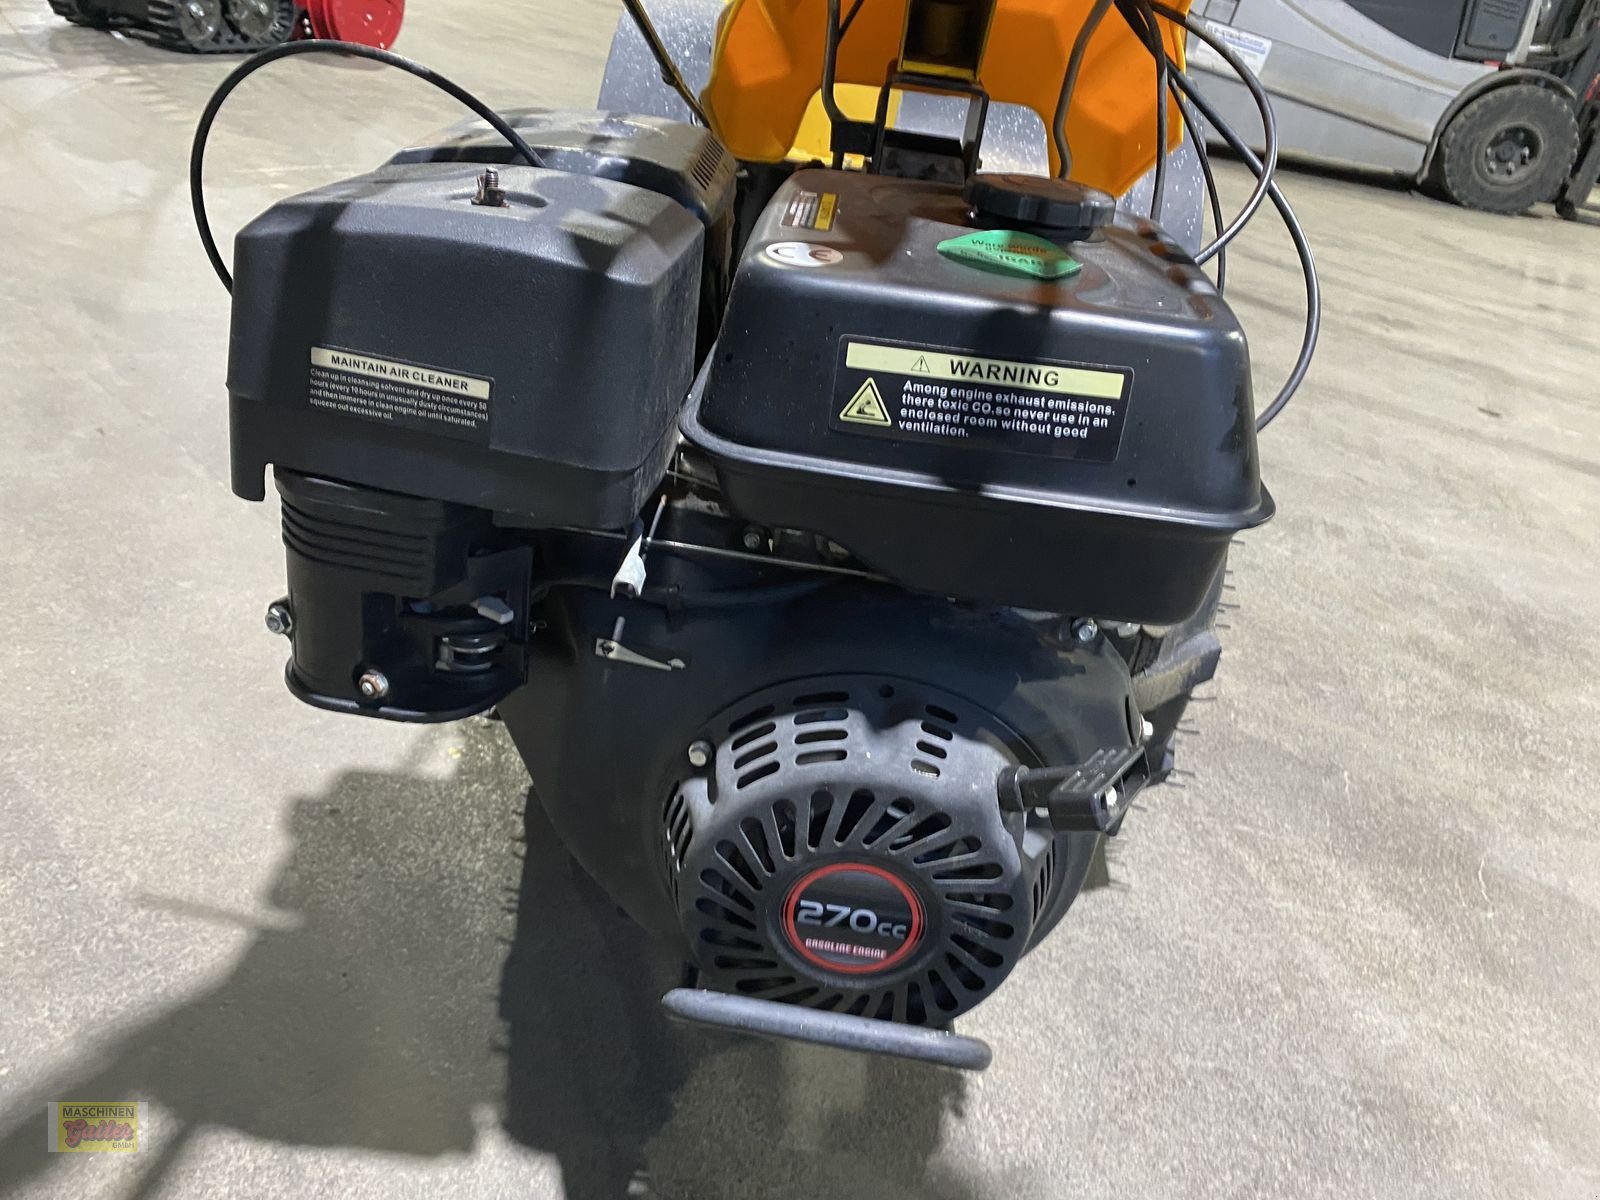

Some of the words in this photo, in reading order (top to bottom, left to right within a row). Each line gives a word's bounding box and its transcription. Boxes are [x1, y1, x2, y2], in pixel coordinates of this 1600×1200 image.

[331, 354, 387, 375] MAINTAIN
[389, 367, 410, 380] AIR
[412, 371, 469, 391] CLEANER
[950, 359, 1060, 386] WARNING
[310, 368, 330, 378] Clean
[340, 373, 347, 381] in
[347, 376, 380, 390] cleansing
[381, 382, 406, 394] solvent
[406, 388, 419, 396] and
[420, 390, 431, 400] dry
[431, 393, 441, 401] up
[441, 395, 458, 404] once
[459, 400, 478, 410] every
[310, 378, 329, 387] hours
[329, 382, 350, 393] (every
[359, 387, 378, 398] hours
[379, 391, 386, 400] in
[418, 399, 438, 410] dusty
[310, 388, 322, 397] and
[323, 390, 338, 400] then
[339, 393, 368, 406] immerse
[368, 398, 375, 407] in
[375, 401, 394, 411] clean
[394, 405, 417, 416] engine
[417, 408, 427, 417] oil
[427, 411, 443, 420] until
[903, 379, 948, 399] Among
[950, 387, 993, 401] engine
[995, 392, 1046, 408] exhaust
[310, 398, 337, 409] squeeze
[337, 403, 349, 412] out
[349, 405, 382, 418] excessive
[900, 408, 960, 424] enclosed
[963, 415, 997, 428] room
[1001, 419, 1052, 435] without
[1054, 425, 1088, 439] good
[902, 393, 935, 408] there
[937, 398, 969, 412] toxic
[1014, 407, 1050, 421] never
[1052, 412, 1075, 425] use
[1078, 413, 1090, 426] in
[1093, 417, 1108, 428] an
[797, 899, 907, 940] 270cc
[805, 938, 851, 955] GASOLINE
[852, 944, 888, 960] ENGINE
